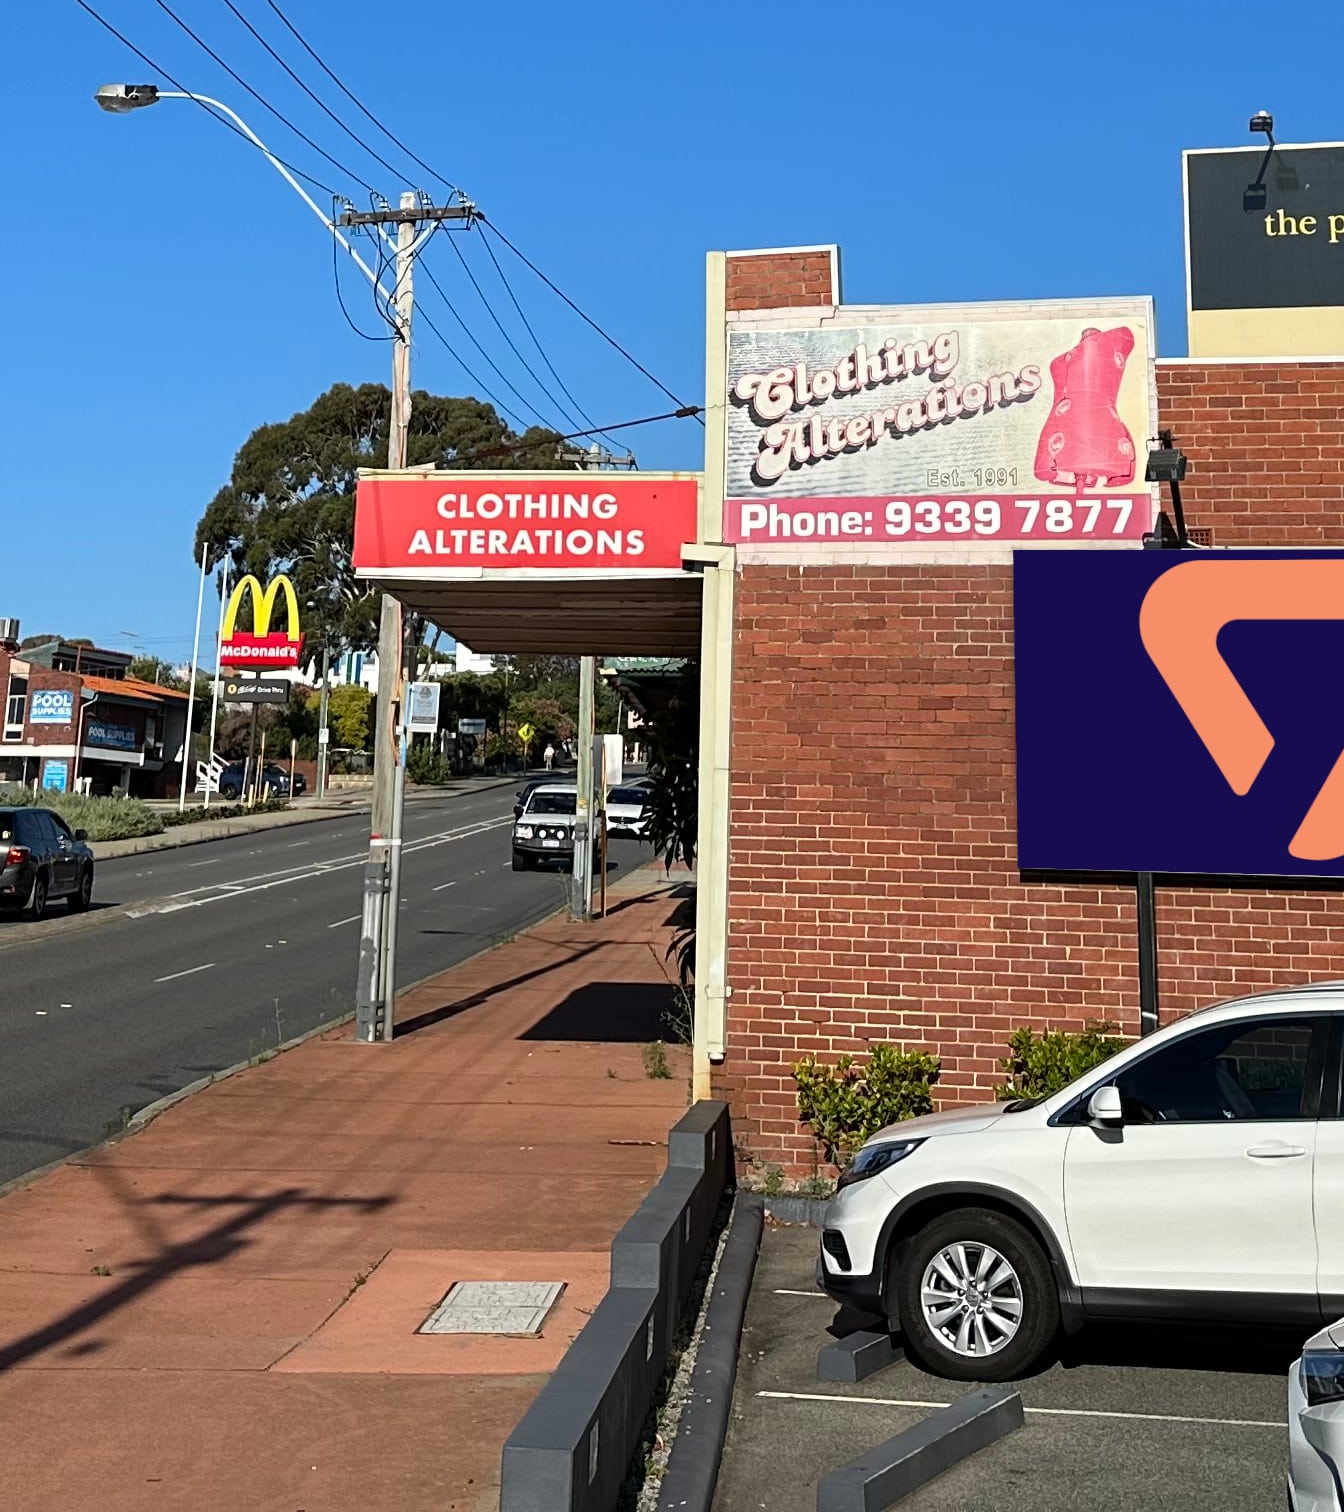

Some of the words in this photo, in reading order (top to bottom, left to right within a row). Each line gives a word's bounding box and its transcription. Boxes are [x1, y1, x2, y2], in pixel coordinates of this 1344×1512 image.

[1264, 208, 1316, 237] the
[735, 330, 961, 422] Clothing
[757, 364, 1042, 478] Alterations
[926, 468, 967, 487] Est.
[975, 467, 1019, 487] 1991
[436, 493, 619, 520] CLOTHING
[740, 503, 874, 537] Phone:
[884, 500, 1001, 536] 9339
[1014, 499, 1134, 535] 7877
[407, 528, 646, 556] ALTERATIONS
[220, 645, 297, 658] McDonald's
[31, 707, 72, 716] SUPPLIES
[32, 694, 72, 707] POOL
[88, 726, 106, 739] POOL
[106, 728, 136, 742] SUPPLIES
